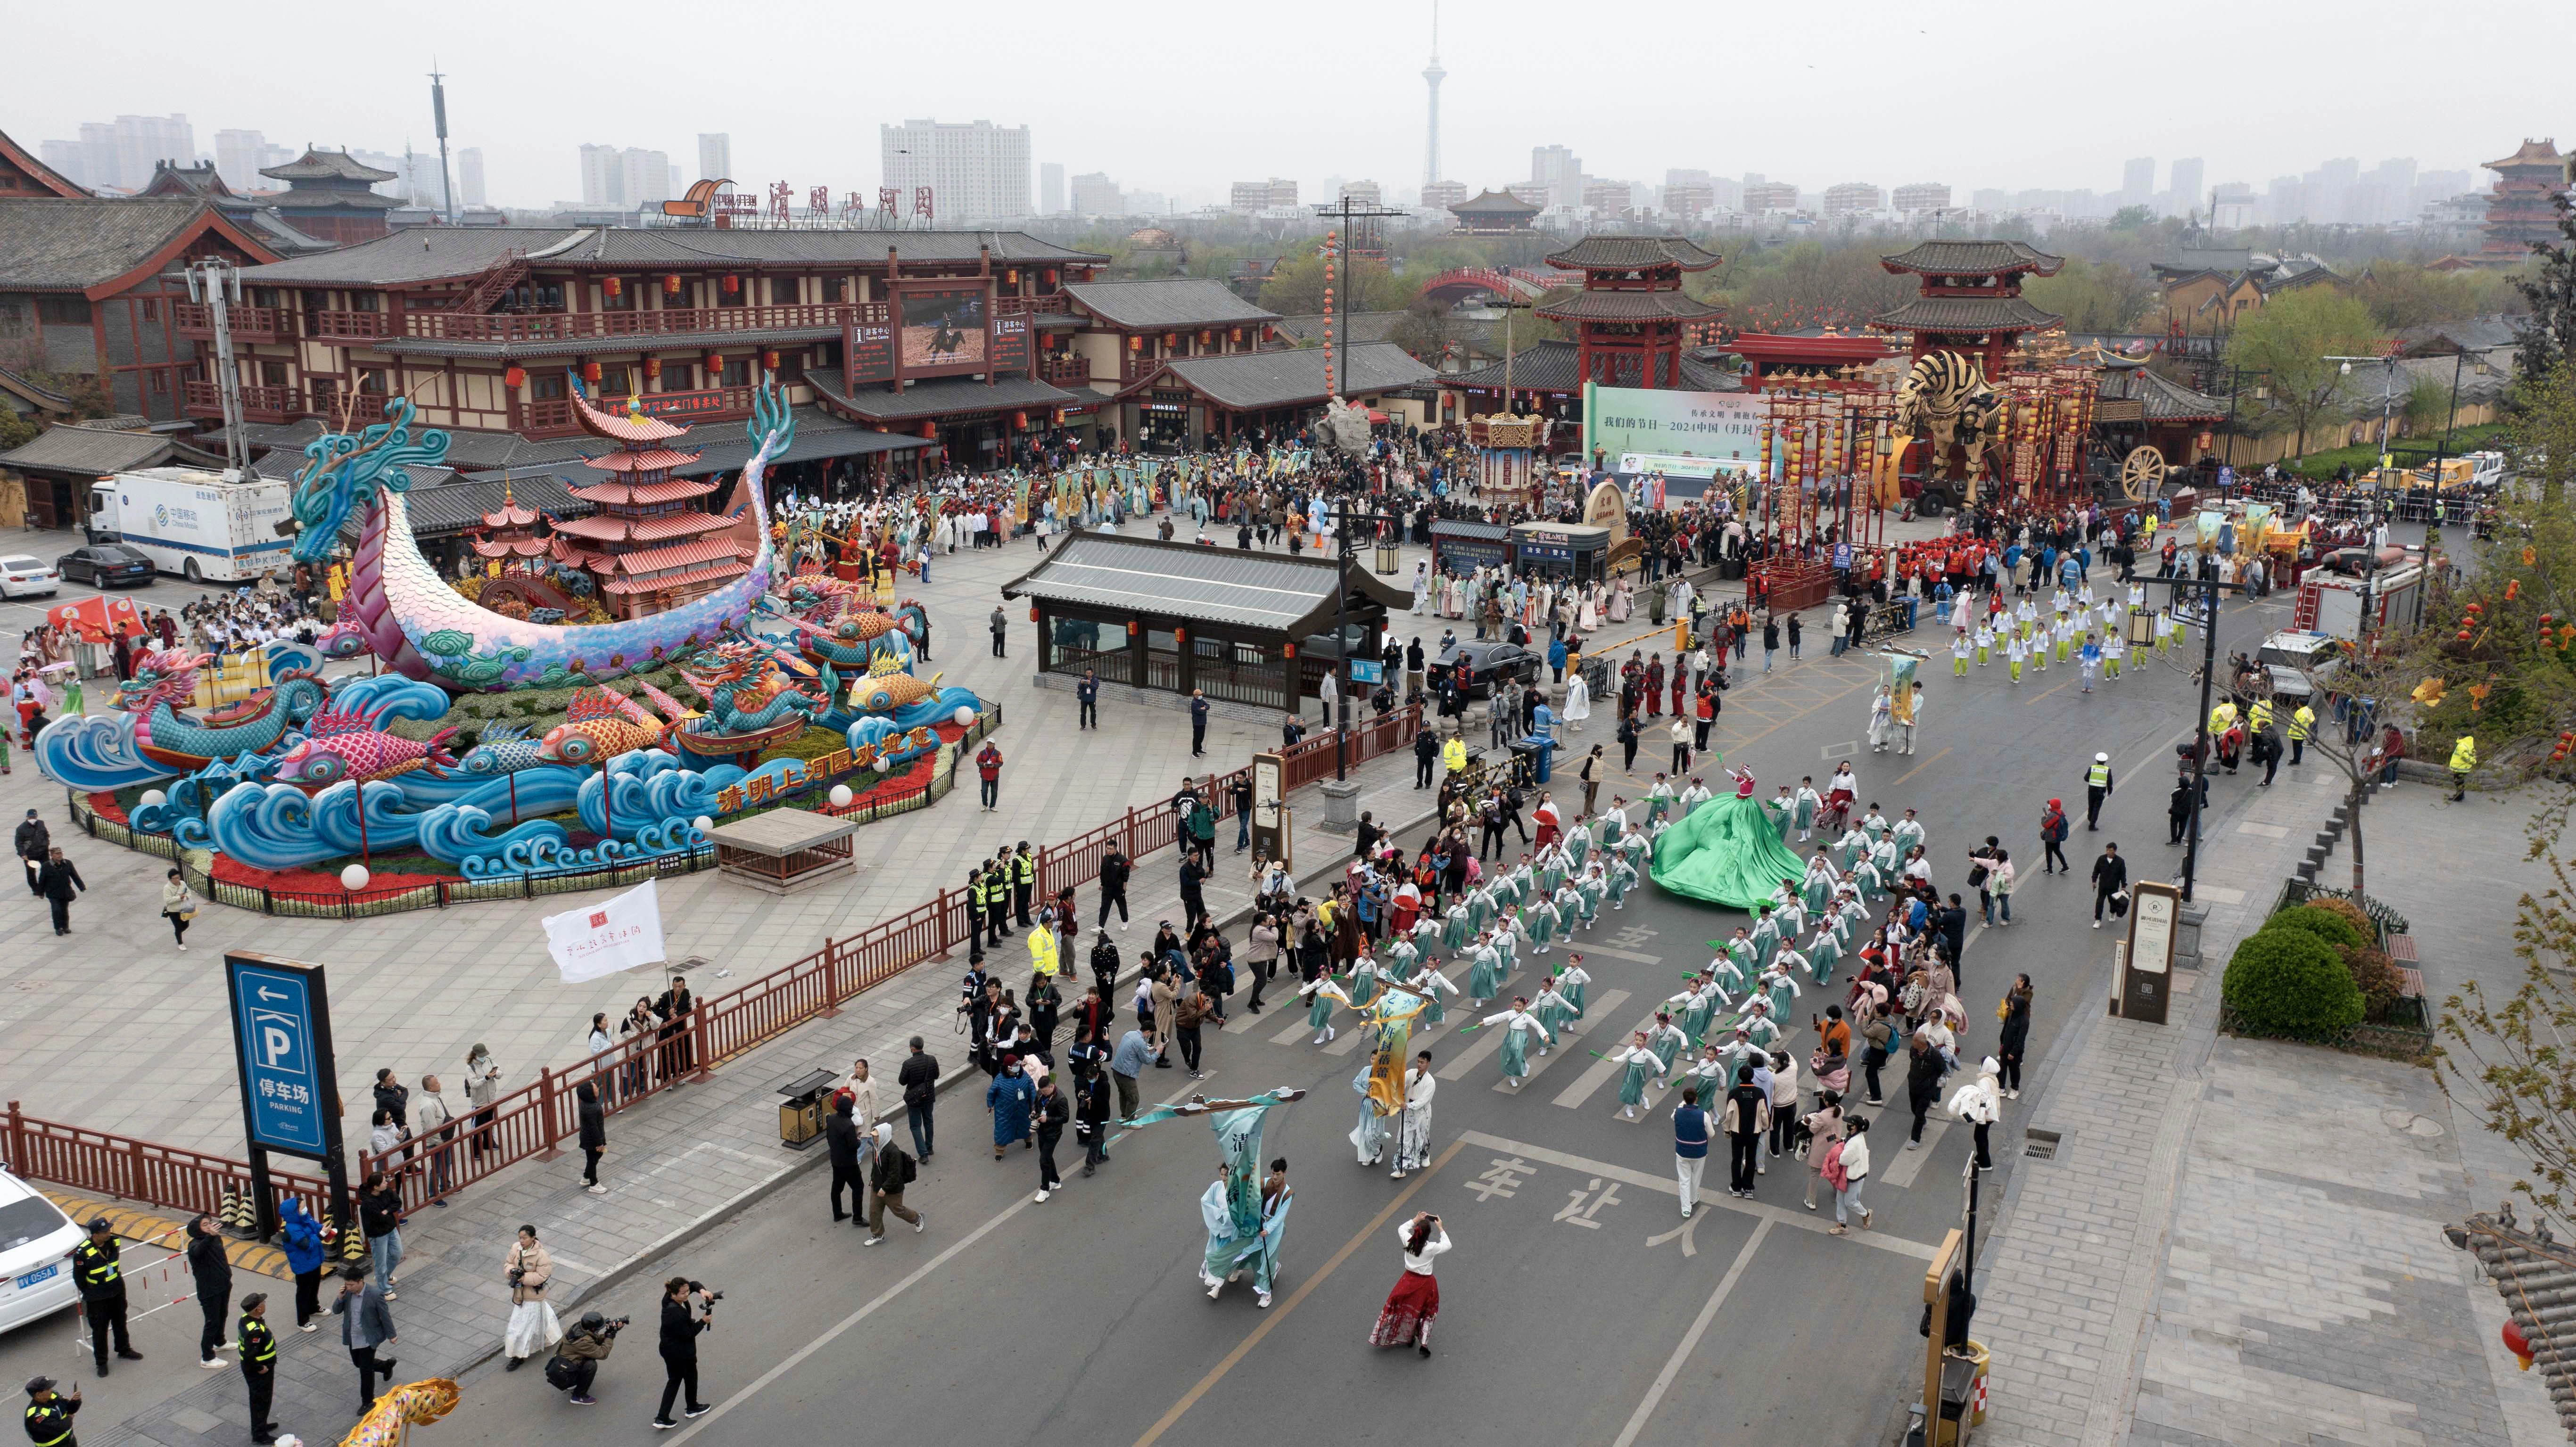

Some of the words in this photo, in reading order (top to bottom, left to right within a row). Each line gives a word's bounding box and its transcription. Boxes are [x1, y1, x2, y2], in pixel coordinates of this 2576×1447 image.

[770, 180, 933, 222] 清明上河园
[866, 327, 890, 335] 游客中心
[609, 396, 720, 416] 清明河园迎宾门售票处
[170, 508, 197, 521] 中国移动
[1527, 547, 1541, 555] 治安
[716, 726, 932, 813] 清明上河园欢迎您
[260, 1078, 309, 1104] 停车场
[270, 1102, 302, 1118] PARKING
